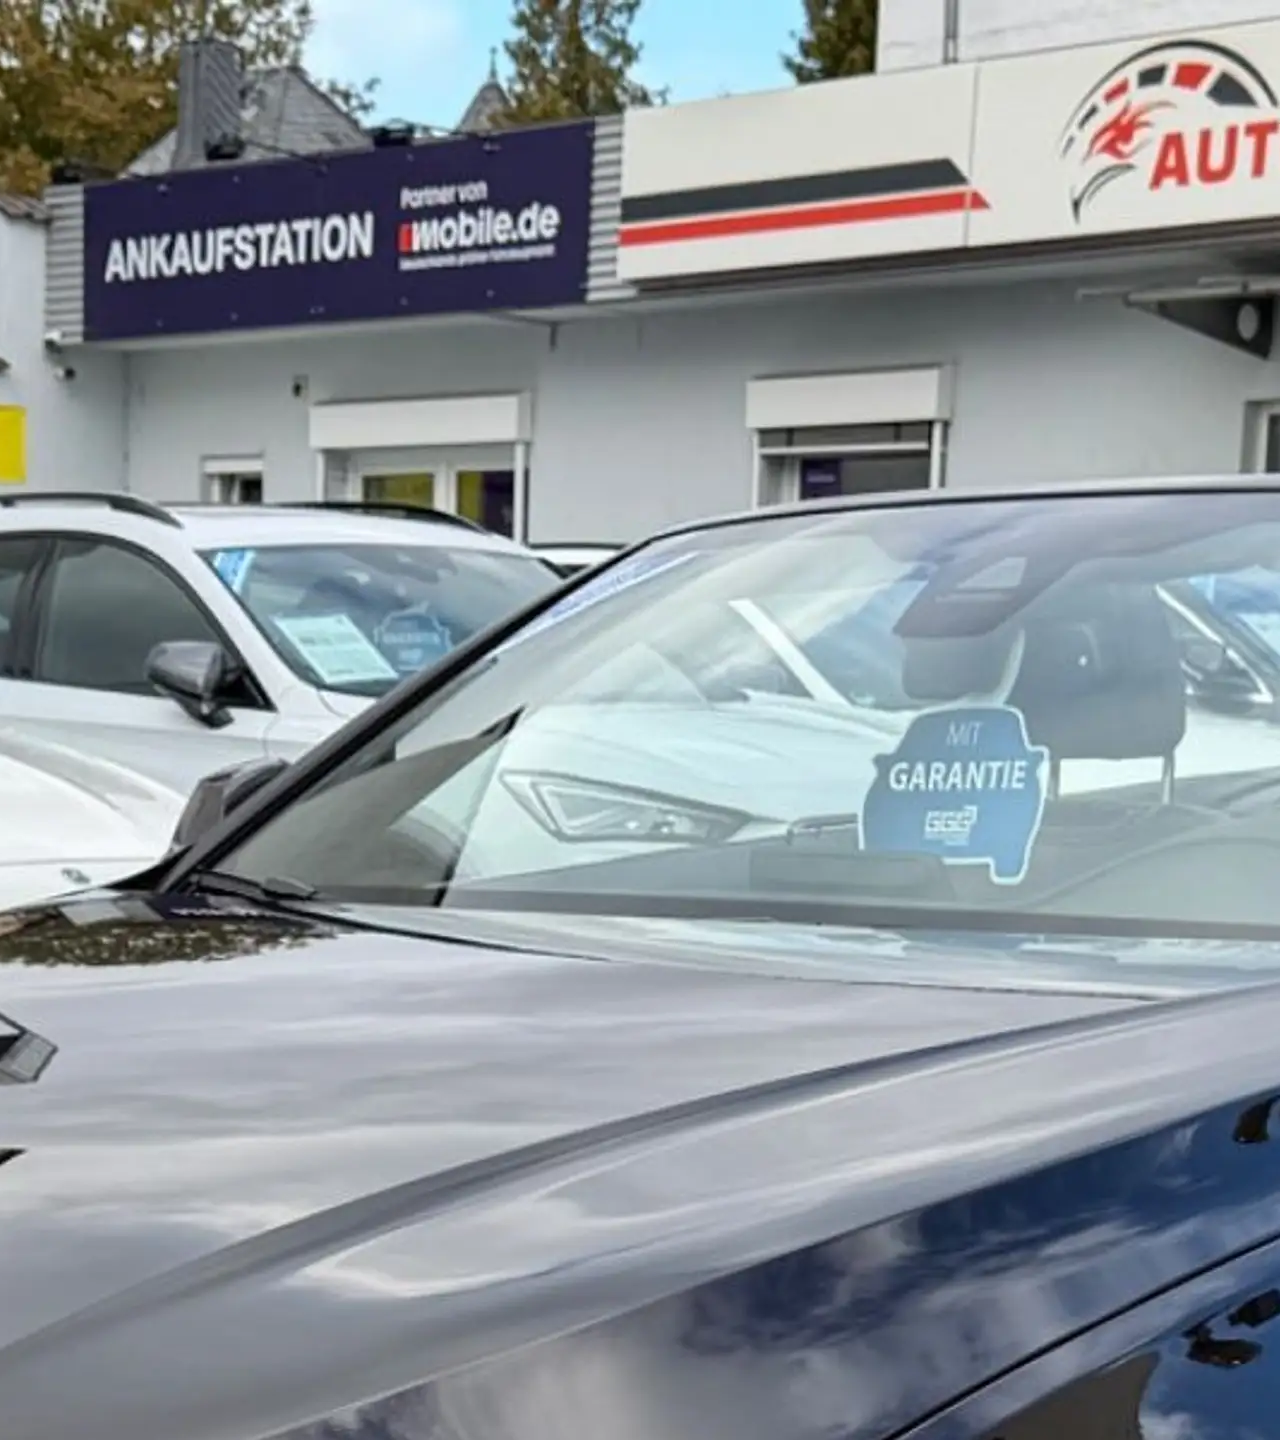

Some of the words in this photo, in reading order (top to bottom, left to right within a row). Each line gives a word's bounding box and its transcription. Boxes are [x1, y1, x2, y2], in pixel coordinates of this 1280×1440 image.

[400, 183, 456, 209] Partner
[457, 179, 488, 203] von
[411, 200, 561, 252] mobile.de
[105, 210, 374, 283] ANKAUFSTATION
[946, 721, 983, 746] MIT
[888, 759, 1029, 792] GARANTIE
